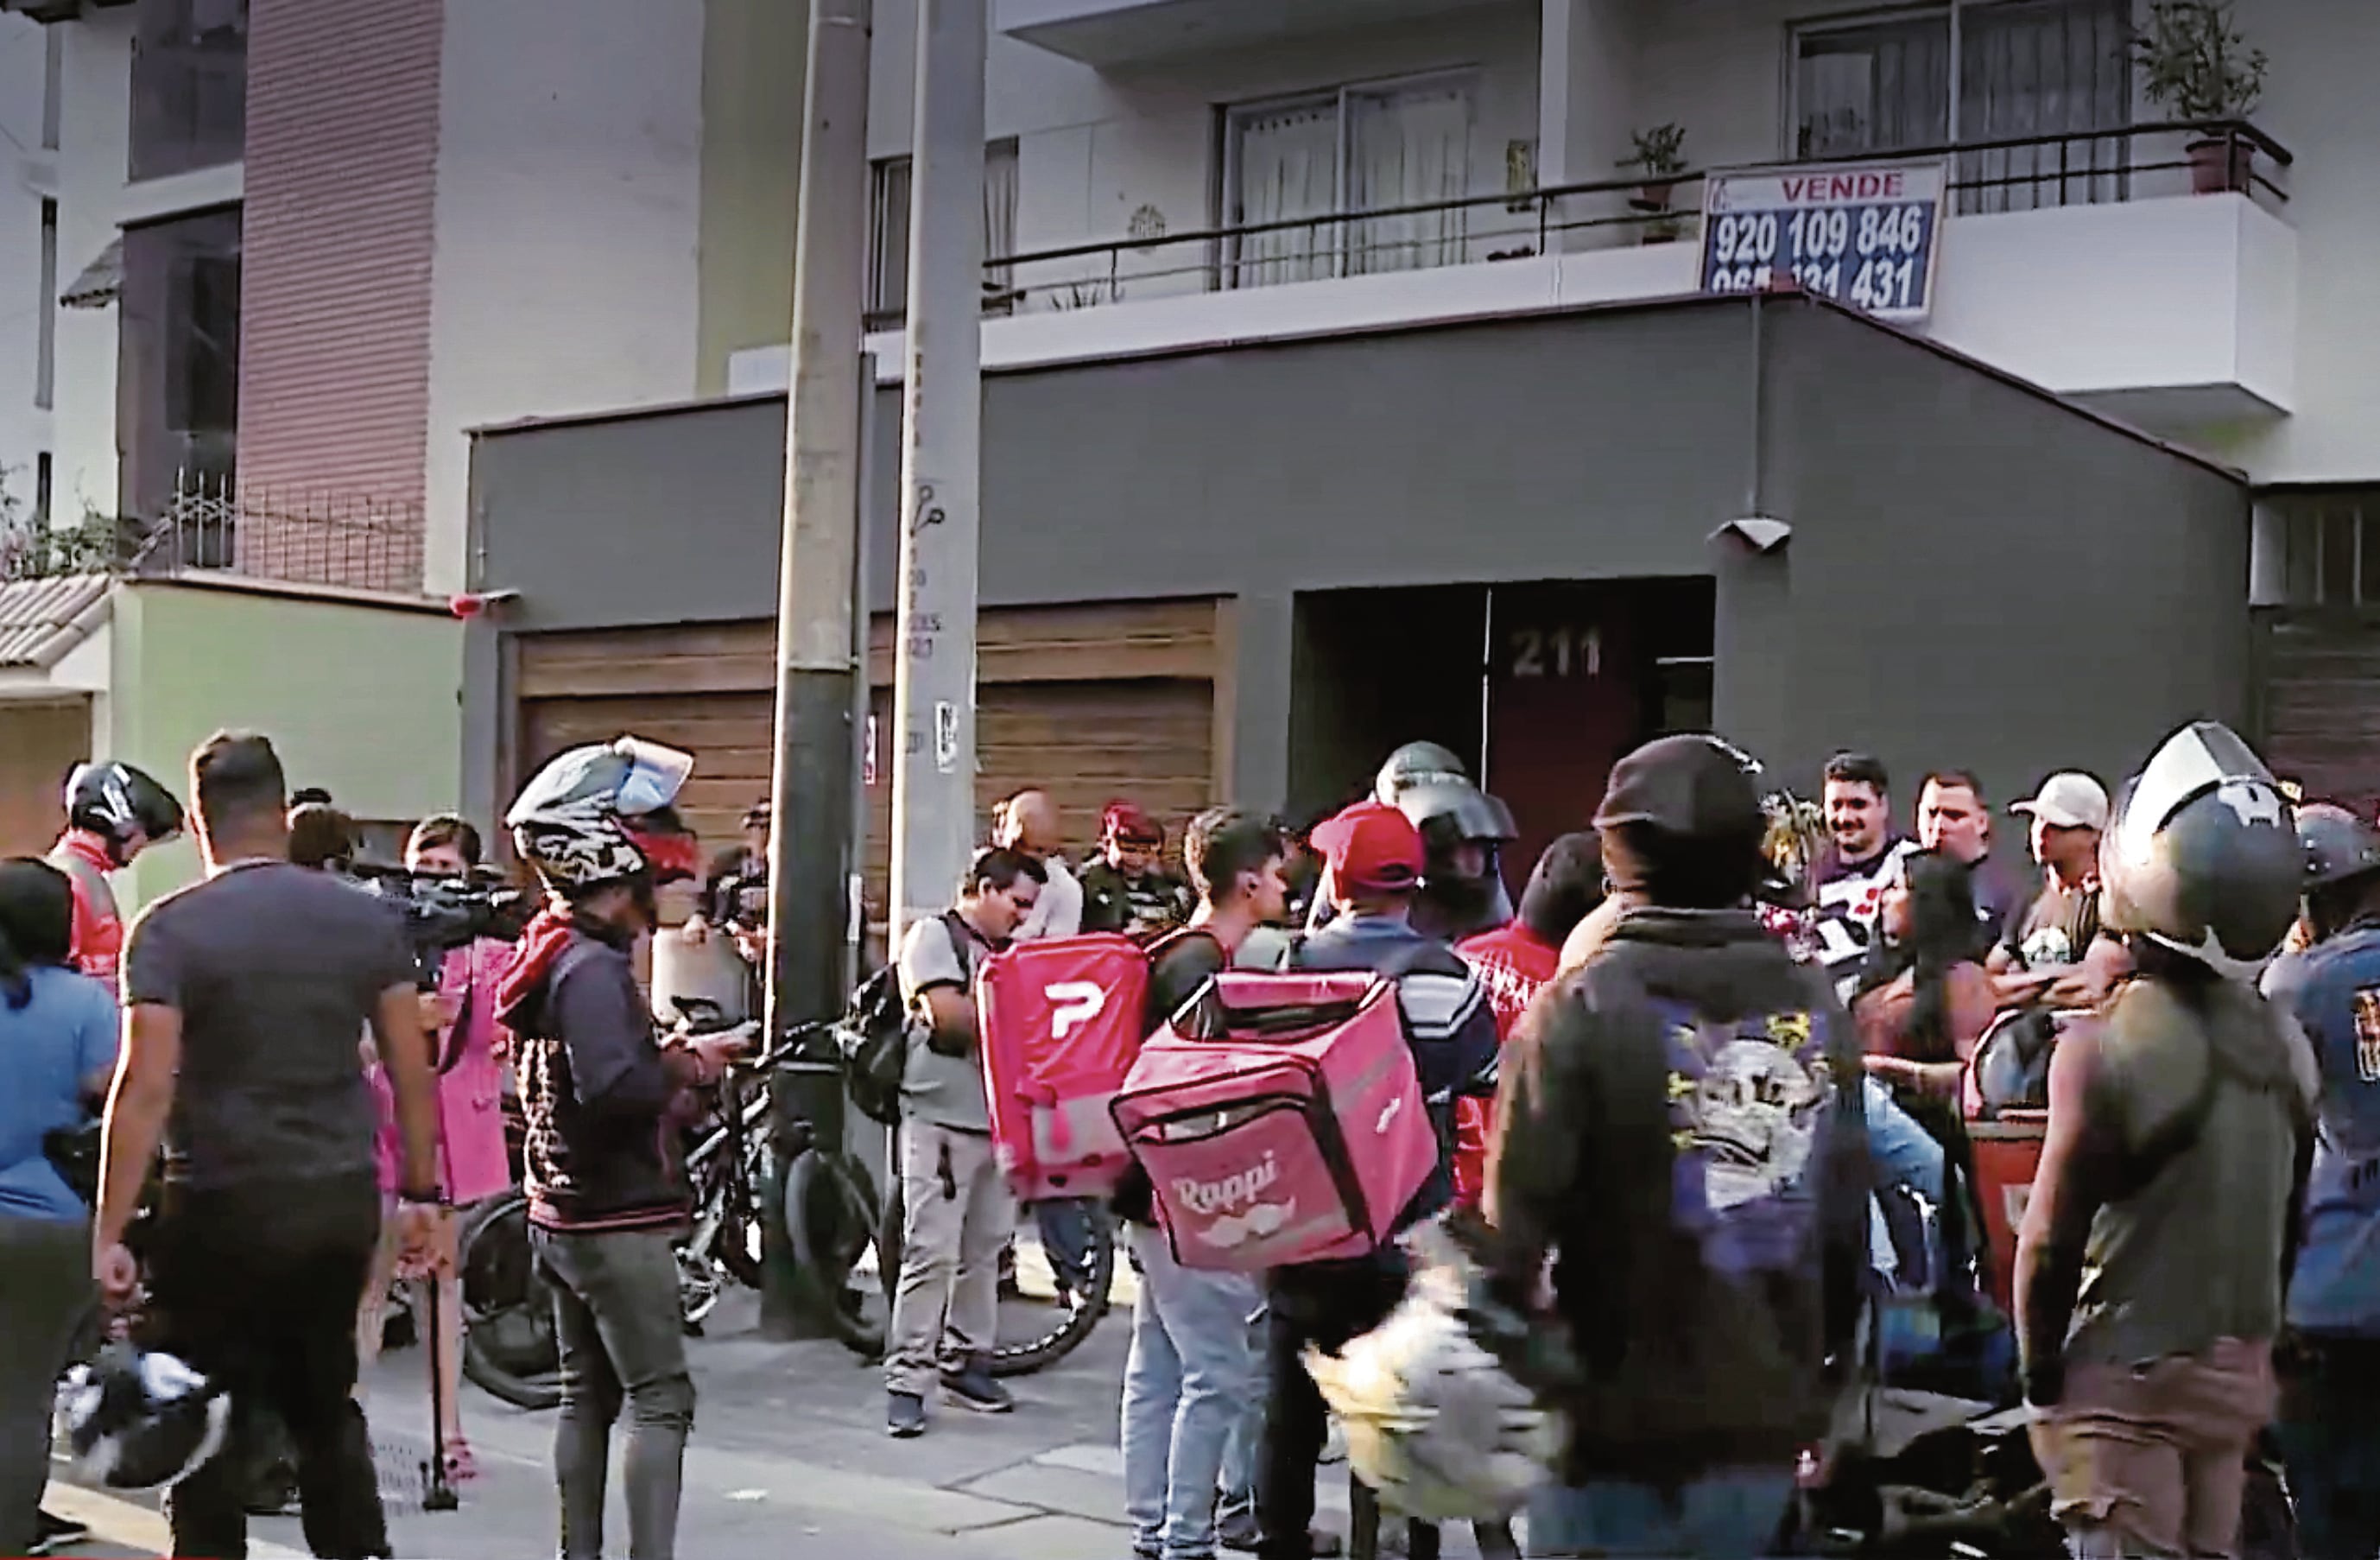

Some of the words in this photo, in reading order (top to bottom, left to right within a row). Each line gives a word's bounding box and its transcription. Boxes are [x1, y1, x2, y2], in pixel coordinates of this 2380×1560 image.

[1782, 174, 1904, 202] VENDE
[1716, 214, 1777, 263] 920
[1788, 209, 1848, 258] 109
[1857, 205, 1922, 257] 846
[1850, 257, 1914, 308] 431
[1511, 629, 1599, 675] 211
[1171, 1149, 1277, 1214] Rappi
